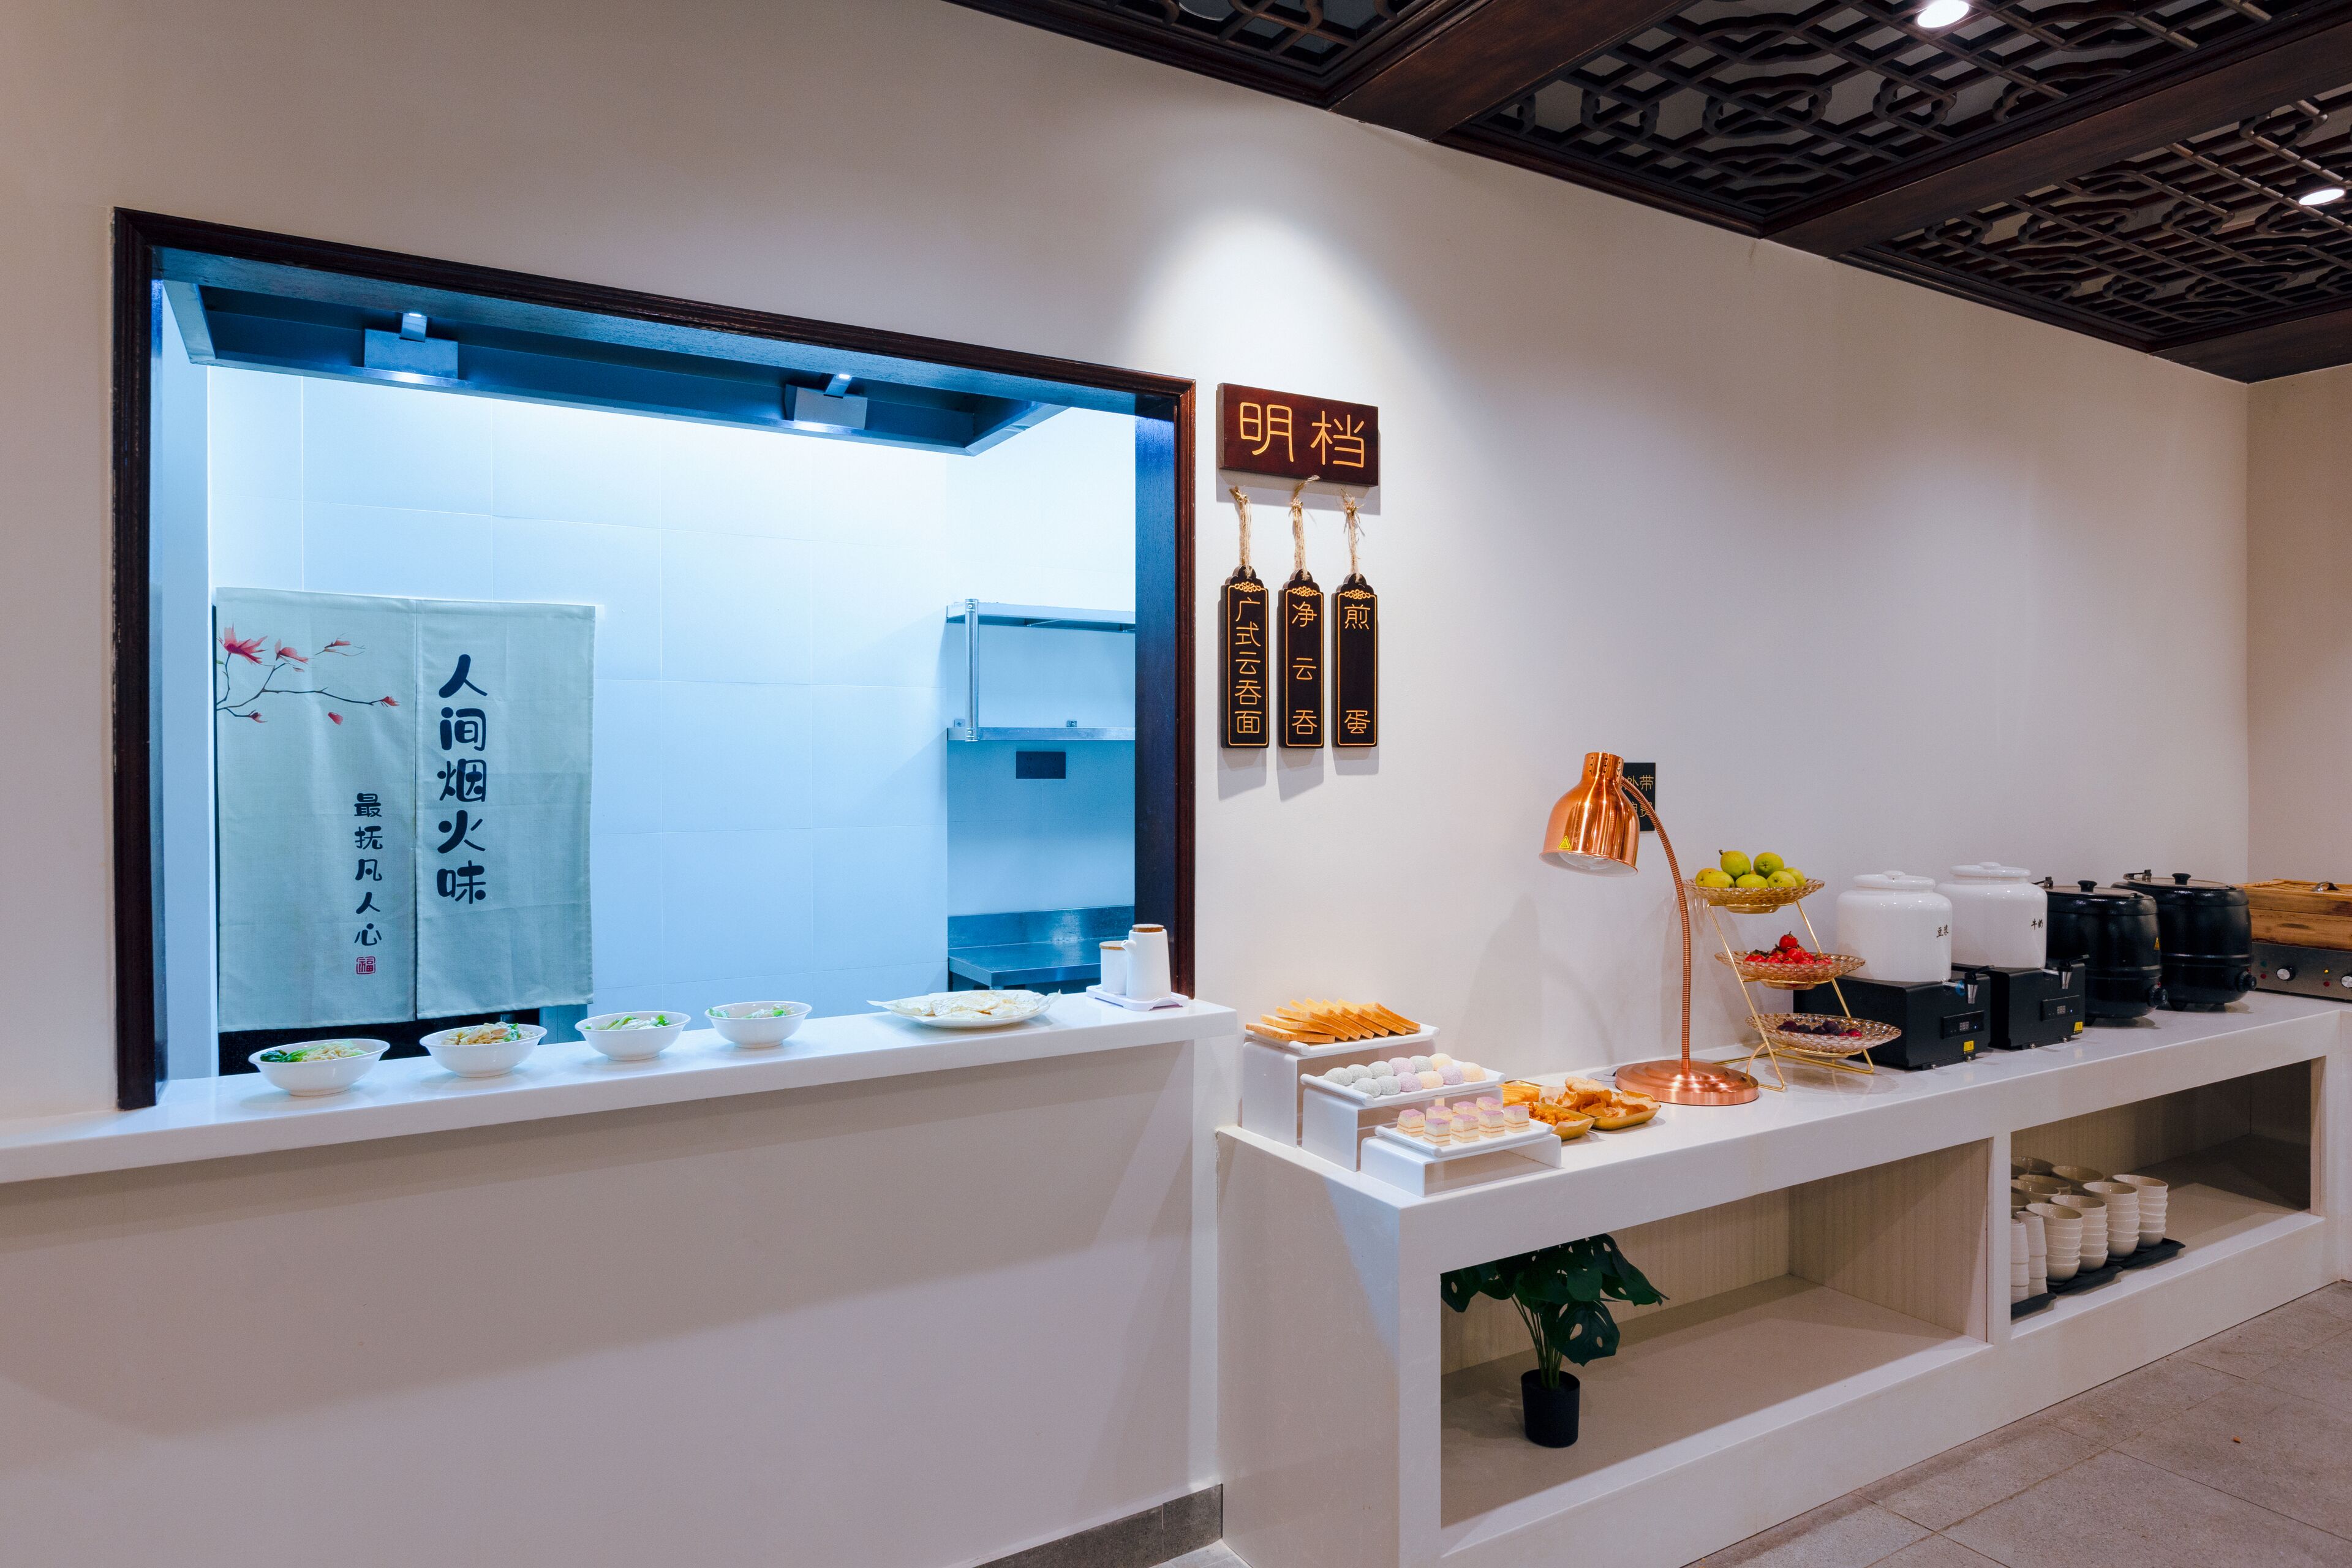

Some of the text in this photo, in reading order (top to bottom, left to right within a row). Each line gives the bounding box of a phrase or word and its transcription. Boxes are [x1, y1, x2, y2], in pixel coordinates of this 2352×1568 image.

[1240, 402, 1365, 468] 明档
[1234, 597, 1262, 734] 广式云吞面
[1292, 601, 1318, 734] 净云吞
[1344, 604, 1371, 734] 煎蛋
[436, 654, 488, 905] 人间烟火味
[353, 793, 383, 946] 最抚凡人心
[2030, 918, 2043, 930] 牛奶
[358, 957, 374, 973] 福
